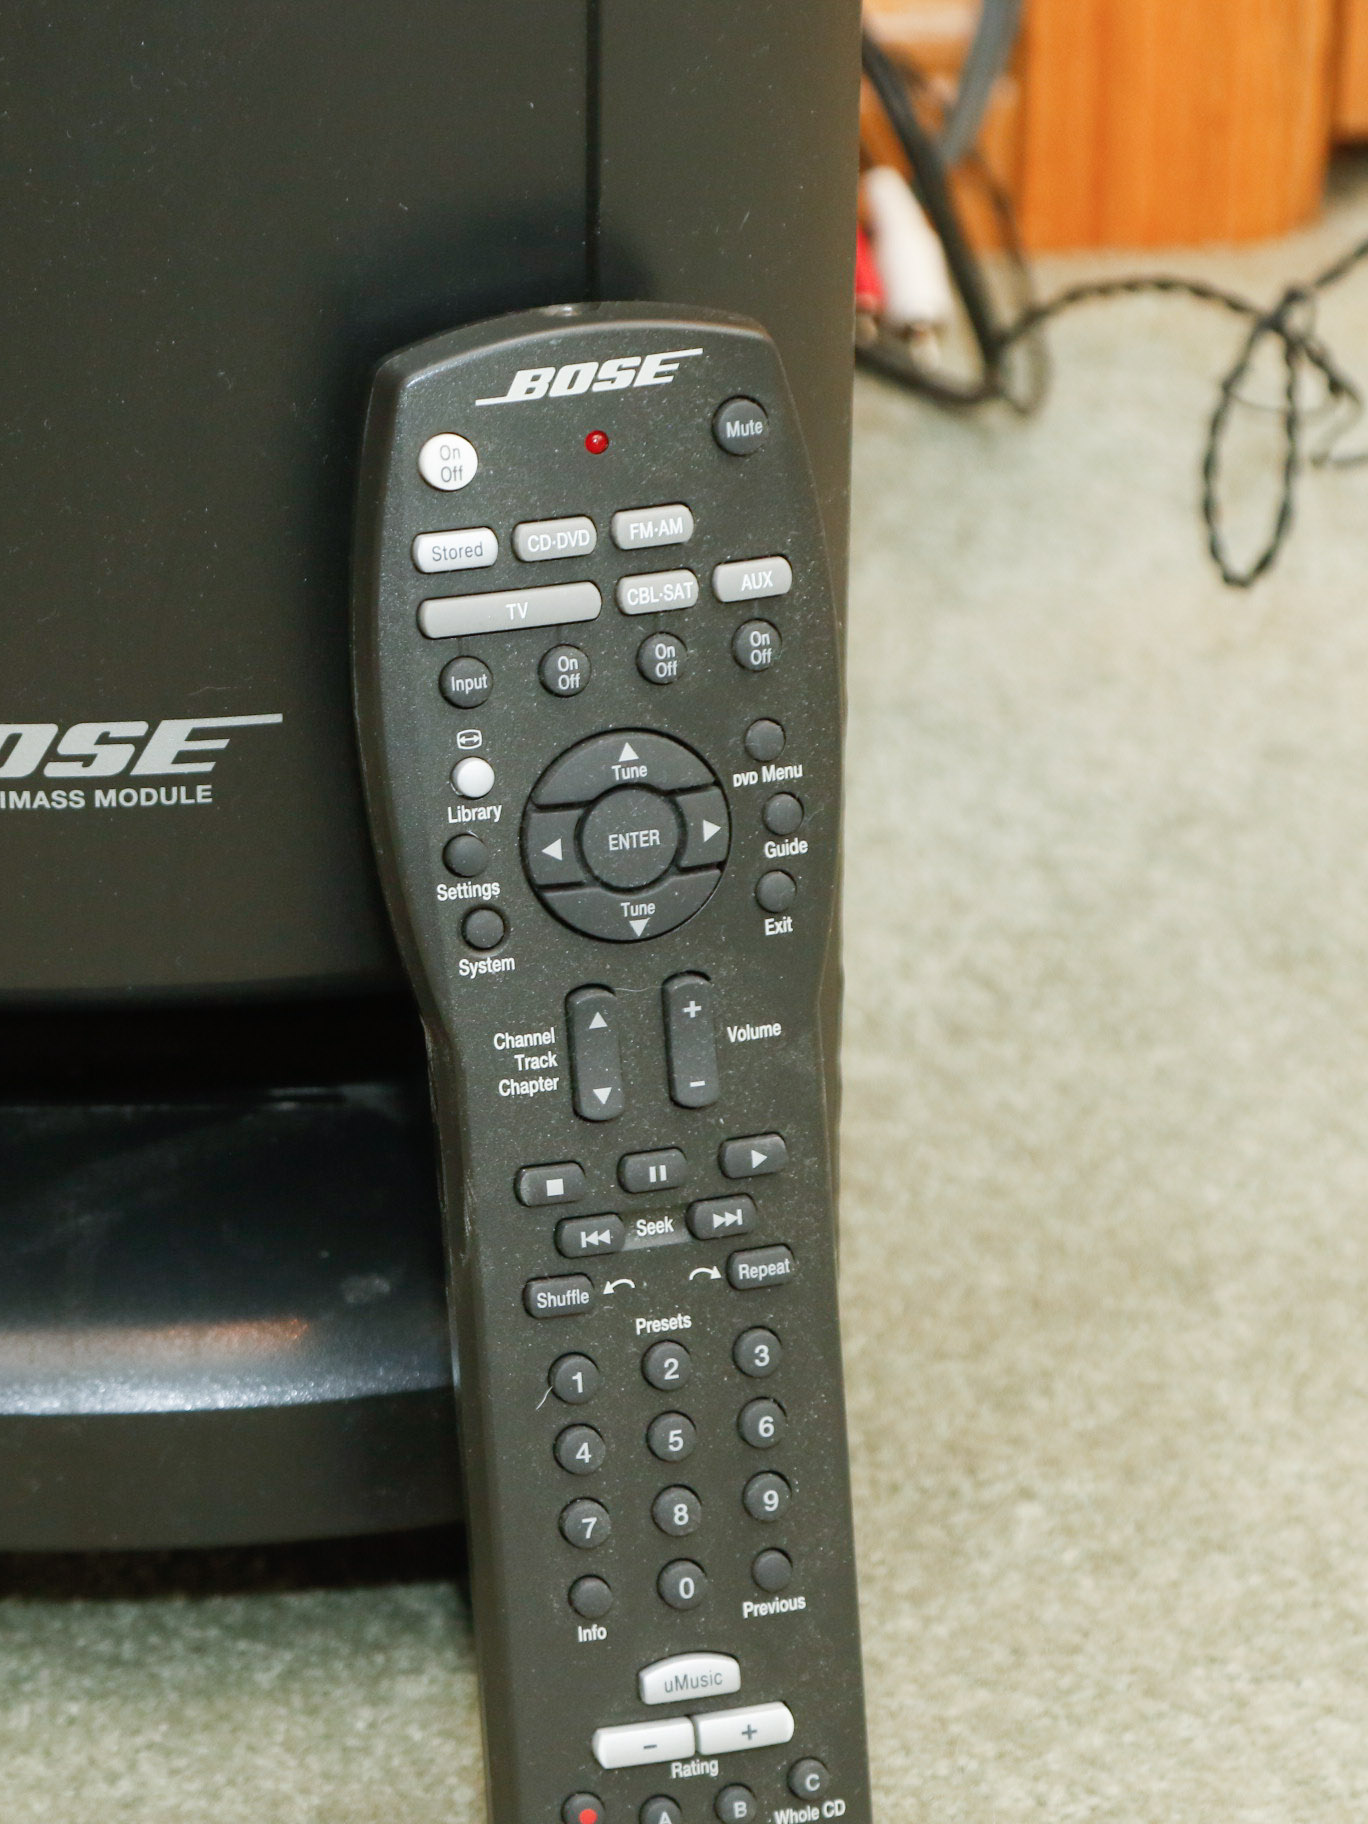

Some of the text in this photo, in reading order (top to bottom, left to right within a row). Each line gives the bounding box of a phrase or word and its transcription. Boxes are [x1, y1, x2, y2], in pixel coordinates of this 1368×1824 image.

[475, 348, 703, 406] BOSE
[726, 419, 763, 437] Mute
[440, 445, 460, 460] On
[441, 467, 463, 483] Off
[432, 542, 483, 561] Stored
[741, 571, 773, 591] AUX
[507, 602, 528, 619] TV
[750, 632, 770, 646] On
[655, 644, 675, 659] On
[750, 648, 772, 664] Off
[558, 656, 578, 671] On
[656, 661, 677, 677] Off
[451, 674, 487, 693] Input
[558, 674, 580, 690] Off
[612, 763, 647, 780] Tune
[733, 763, 802, 787] DVD Menu
[95, 785, 213, 807] MODULE
[448, 804, 501, 824] Library
[609, 831, 660, 851] ENTER
[765, 839, 808, 858] Guide
[437, 881, 500, 901] Settings
[621, 901, 655, 917] Tune
[765, 917, 792, 935] Exit
[459, 956, 514, 977] System
[494, 1028, 555, 1050] Channel
[728, 1021, 781, 1043] Volume
[515, 1053, 557, 1071] Track
[499, 1076, 559, 1098] Chapter
[637, 1217, 674, 1237] Seek
[739, 1258, 791, 1280] Repeat
[537, 1289, 589, 1309] Shuffle
[636, 1314, 692, 1335] Presets
[754, 1345, 769, 1366] 3
[664, 1359, 679, 1379] 2
[572, 1372, 583, 1393] 1
[759, 1416, 773, 1437] 6
[669, 1430, 683, 1451] 5
[576, 1442, 591, 1463] 4
[763, 1490, 778, 1511] 9
[674, 1504, 689, 1525] 8
[582, 1518, 597, 1539] 7
[679, 1578, 694, 1598] 0
[743, 1596, 806, 1618] Previous
[578, 1625, 607, 1642] Info
[665, 1670, 723, 1693] uMusic
[671, 1759, 718, 1779] Rating
[806, 1774, 820, 1790] C
[658, 1812, 671, 1824] A
[734, 1802, 746, 1817] B
[775, 1801, 845, 1824] Whole CD
